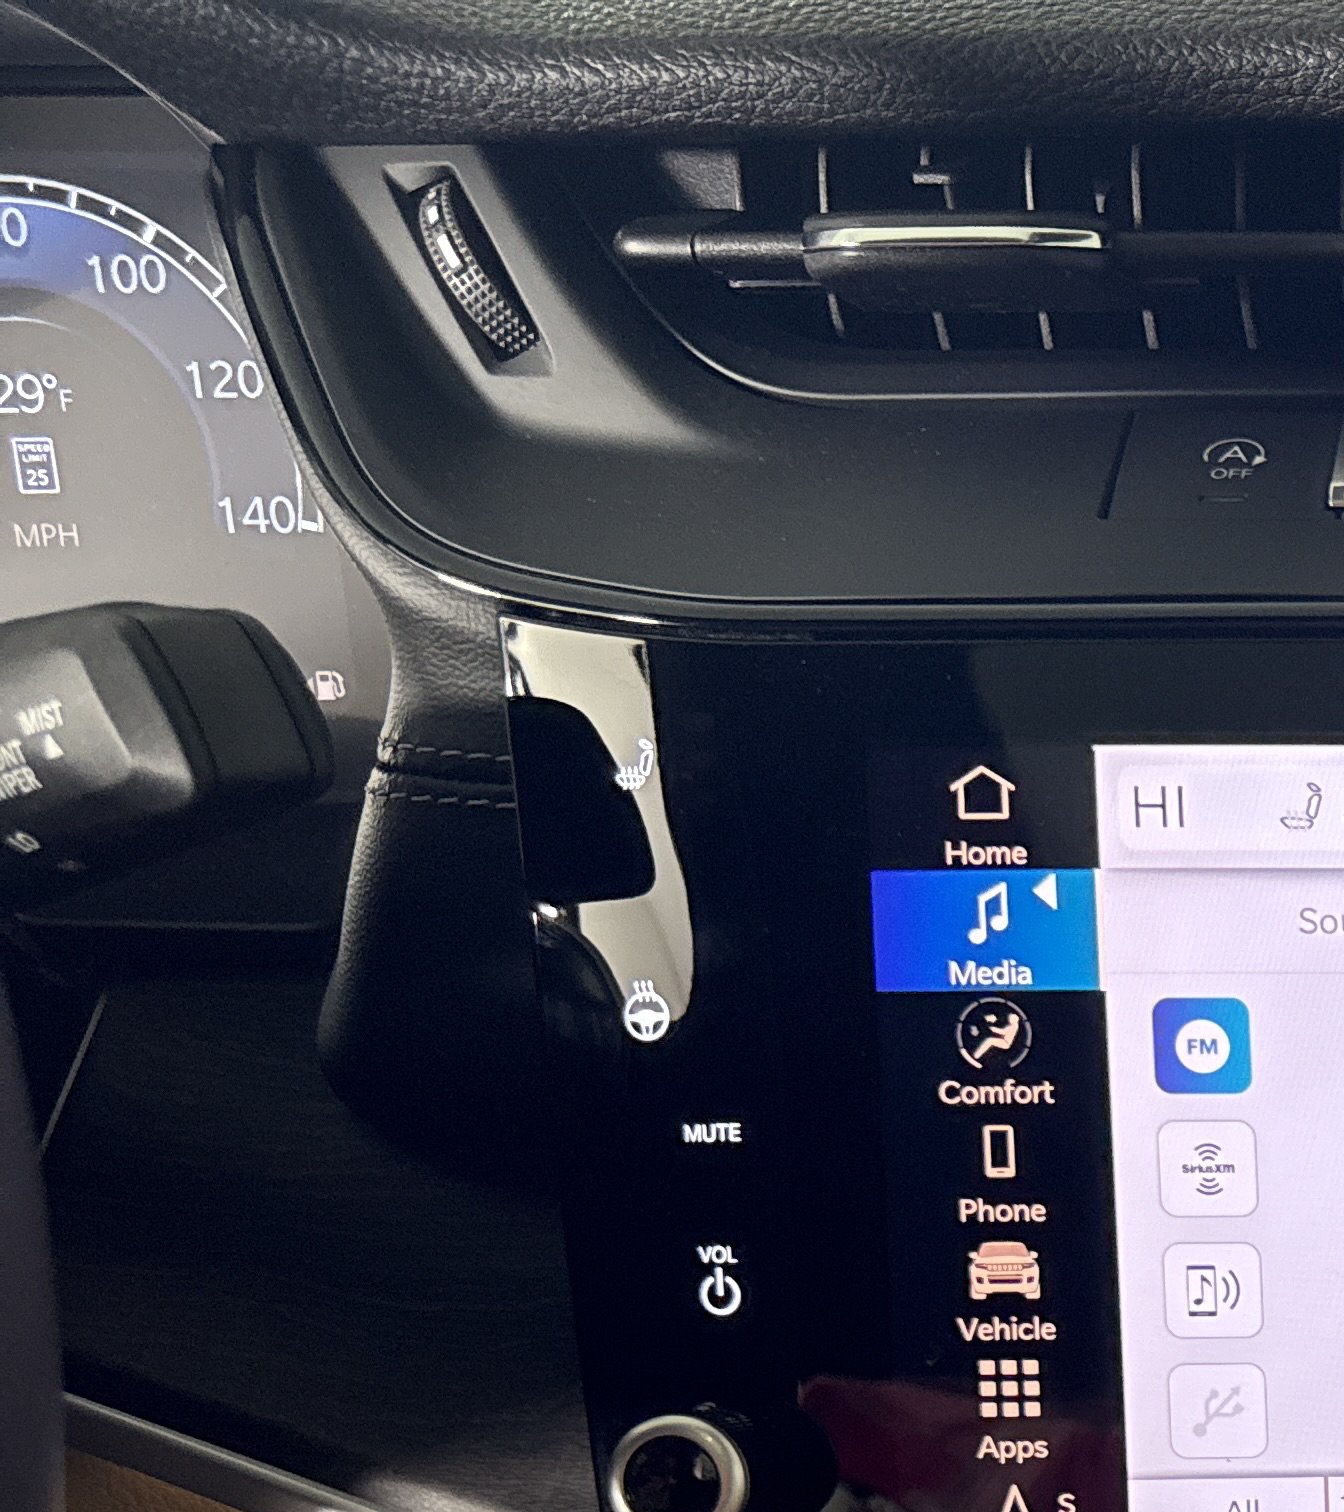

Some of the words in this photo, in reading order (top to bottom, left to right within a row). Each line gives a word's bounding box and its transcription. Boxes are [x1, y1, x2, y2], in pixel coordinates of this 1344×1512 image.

[87, 254, 166, 294] 100
[186, 360, 264, 399] 120
[22, 454, 48, 463] LIMIT
[26, 469, 49, 486] 25
[1210, 467, 1254, 480] OFF
[218, 496, 296, 533] 140
[14, 523, 80, 547] MPH
[17, 700, 63, 735] MIST
[1133, 785, 1185, 828] HI
[944, 841, 1028, 866] Home
[948, 960, 1033, 986] Media
[1187, 1038, 1218, 1055] FM
[938, 1079, 1055, 1105] Comfort
[682, 1122, 742, 1143] MUTE
[957, 1198, 1047, 1224] Phone
[697, 1245, 738, 1264] VOL
[957, 1316, 1057, 1342] Vehicle
[976, 1435, 1049, 1463] Apps
